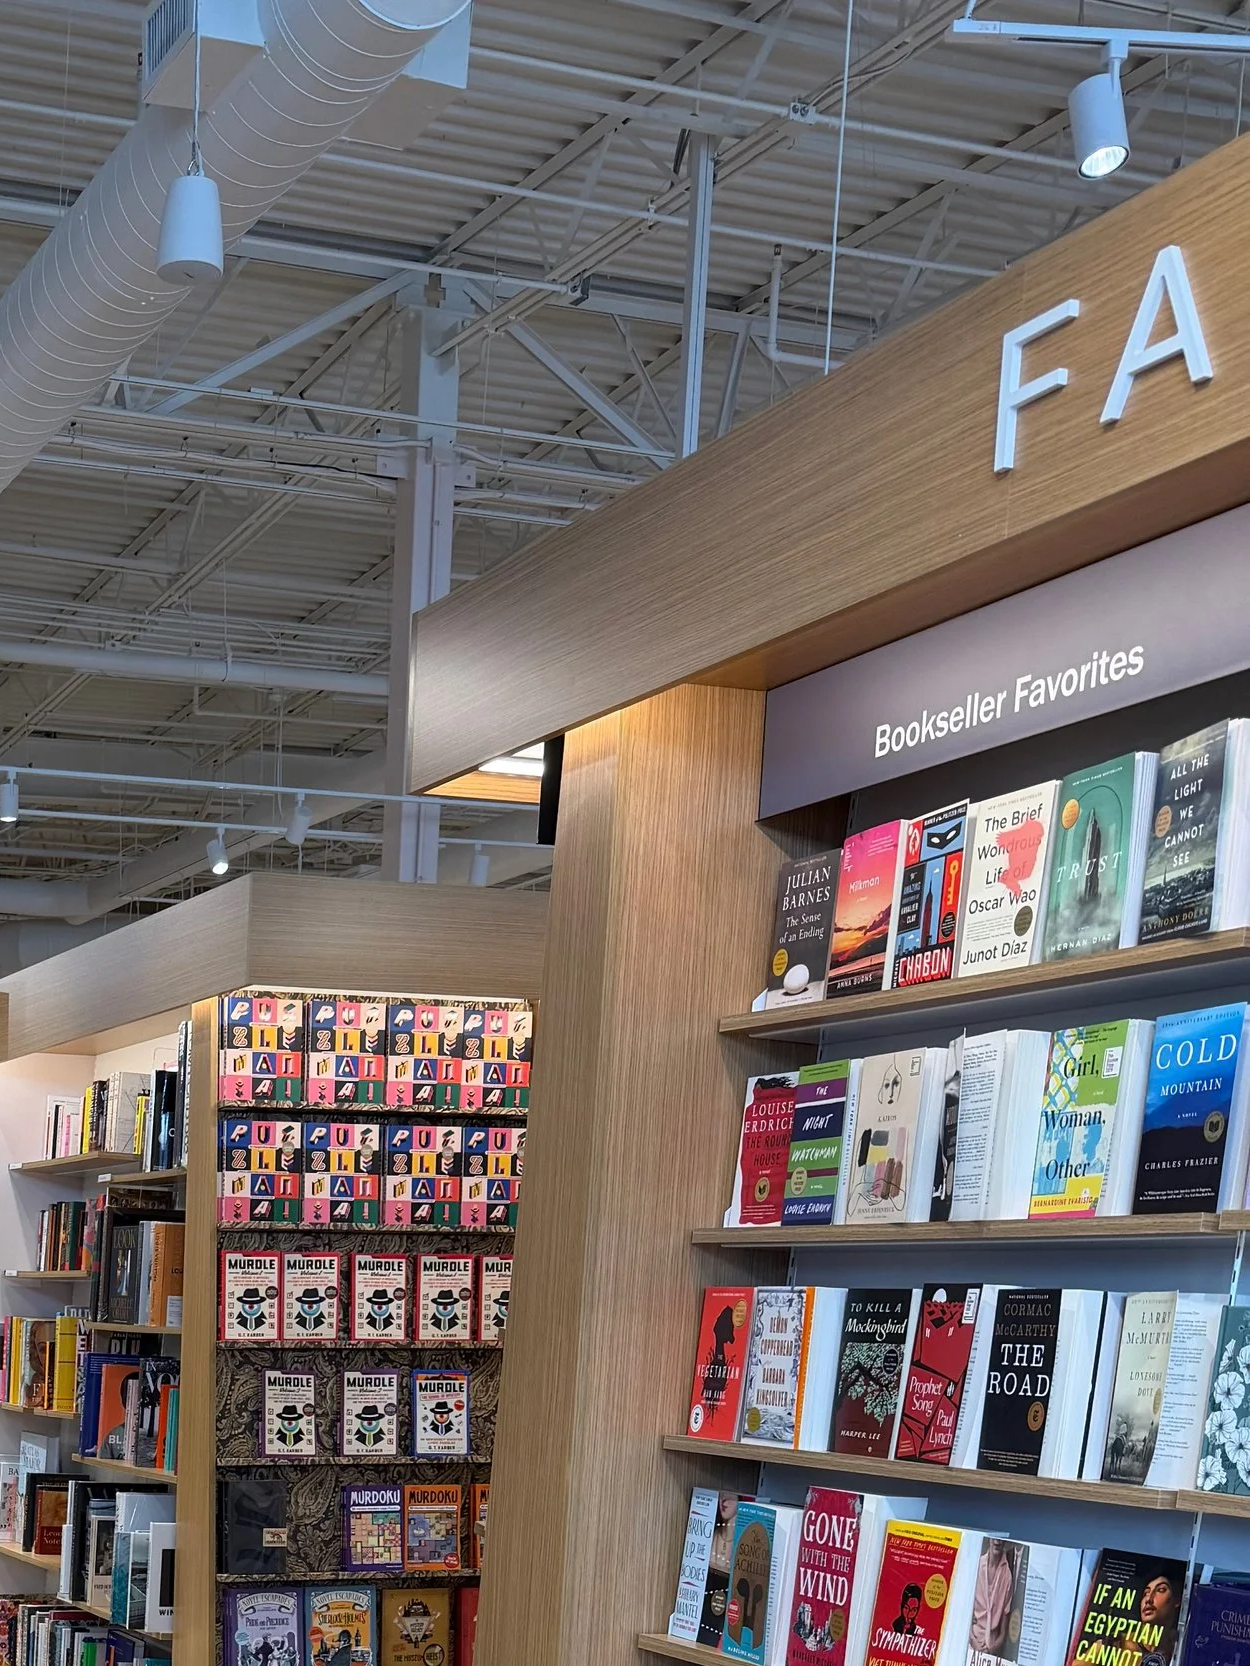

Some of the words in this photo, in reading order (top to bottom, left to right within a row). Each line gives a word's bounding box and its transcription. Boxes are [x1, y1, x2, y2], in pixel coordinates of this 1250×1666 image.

[994, 245, 1213, 472] FA
[874, 688, 1007, 759] Bookseller
[1014, 646, 1145, 716] Favorites
[1170, 766, 1186, 780] ALL
[1191, 753, 1209, 771] THE
[1174, 779, 1203, 800] LIGHT
[985, 816, 1007, 834] The
[1011, 803, 1044, 826] Brief
[1180, 805, 1193, 820] WE
[1164, 824, 1204, 848] CANNOT
[978, 833, 1042, 860] Wondrous
[1056, 851, 1123, 883] TRUST
[1173, 851, 1190, 867] SEE
[786, 866, 831, 894] JULIAN
[782, 887, 831, 910] BARNES
[969, 895, 1005, 915] Oscar
[1008, 889, 1036, 906] Wao
[786, 916, 799, 928] The
[801, 913, 821, 925] Sense
[799, 926, 824, 940] Ending
[963, 943, 999, 965] Junot
[1156, 1034, 1237, 1070] COLD
[1161, 1078, 1222, 1096] MOUNTAIN
[752, 1101, 794, 1117] LOUISE
[803, 1113, 833, 1131] NIGHT
[791, 1146, 838, 1162] WATCHMAN
[1045, 1159, 1090, 1181] Other
[1145, 1159, 1182, 1170] CHARLES
[1185, 1157, 1218, 1167] FRAZIER
[113, 1227, 137, 1249] LOOK
[228, 1259, 276, 1270] MURDLE
[287, 1259, 335, 1271] MURDLE
[358, 1260, 403, 1272] MURDLE
[423, 1260, 469, 1272] MURDLE
[866, 1303, 891, 1312] KILL
[1004, 1304, 1051, 1316] CORMAC
[845, 1317, 907, 1341] Mockingbird
[995, 1324, 1056, 1337] McCARTHY
[1001, 1344, 1045, 1367] THE
[697, 1364, 739, 1379] VEGETARIAN
[268, 1376, 312, 1388] MURDLE
[346, 1377, 394, 1388] MURDLE
[419, 1382, 465, 1393] MURDLE
[910, 1379, 942, 1396] Prophet
[988, 1372, 1049, 1397] ROAD
[913, 1397, 933, 1417] Song
[937, 1409, 955, 1428] Paul
[929, 1430, 952, 1446] Lynch
[350, 1489, 400, 1504] MURDOKU
[409, 1489, 458, 1504] MURDOKU
[803, 1510, 859, 1551] GONE
[801, 1547, 829, 1567] WITH
[831, 1554, 850, 1573] THE
[800, 1568, 848, 1606] WIND
[262, 1594, 291, 1606] ESCAPADES
[335, 1592, 366, 1605] ESCAPADES
[1093, 1584, 1108, 1605] IF
[1111, 1587, 1136, 1611] AN
[245, 1617, 259, 1626] PRIDE
[1084, 1612, 1164, 1647] EGYPTIAN
[872, 1627, 936, 1658] SYMPATHIZER
